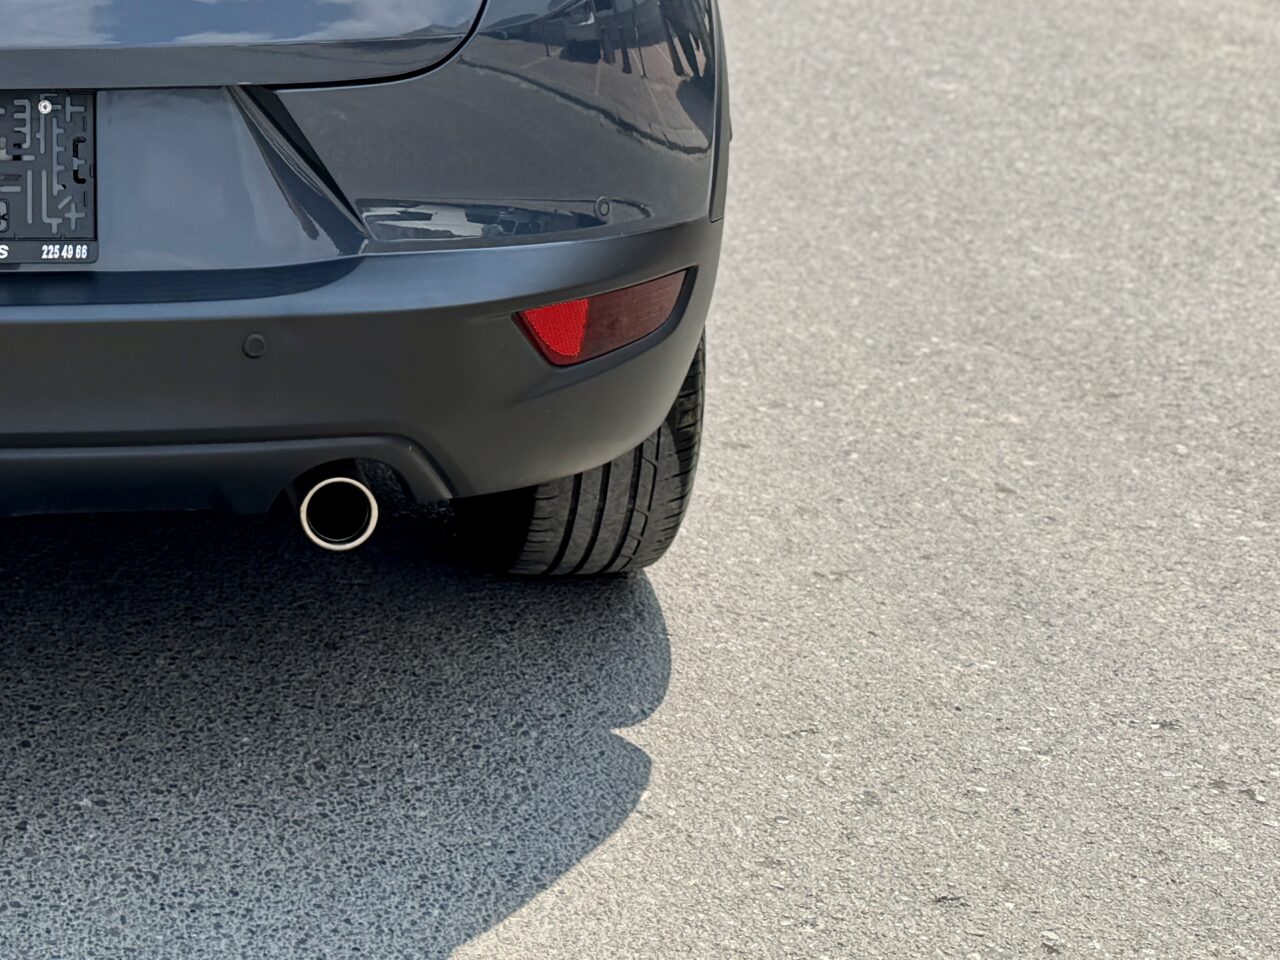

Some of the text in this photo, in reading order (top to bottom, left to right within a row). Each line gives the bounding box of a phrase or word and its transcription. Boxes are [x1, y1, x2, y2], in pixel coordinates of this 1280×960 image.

[41, 244, 88, 259] 225 49 66
